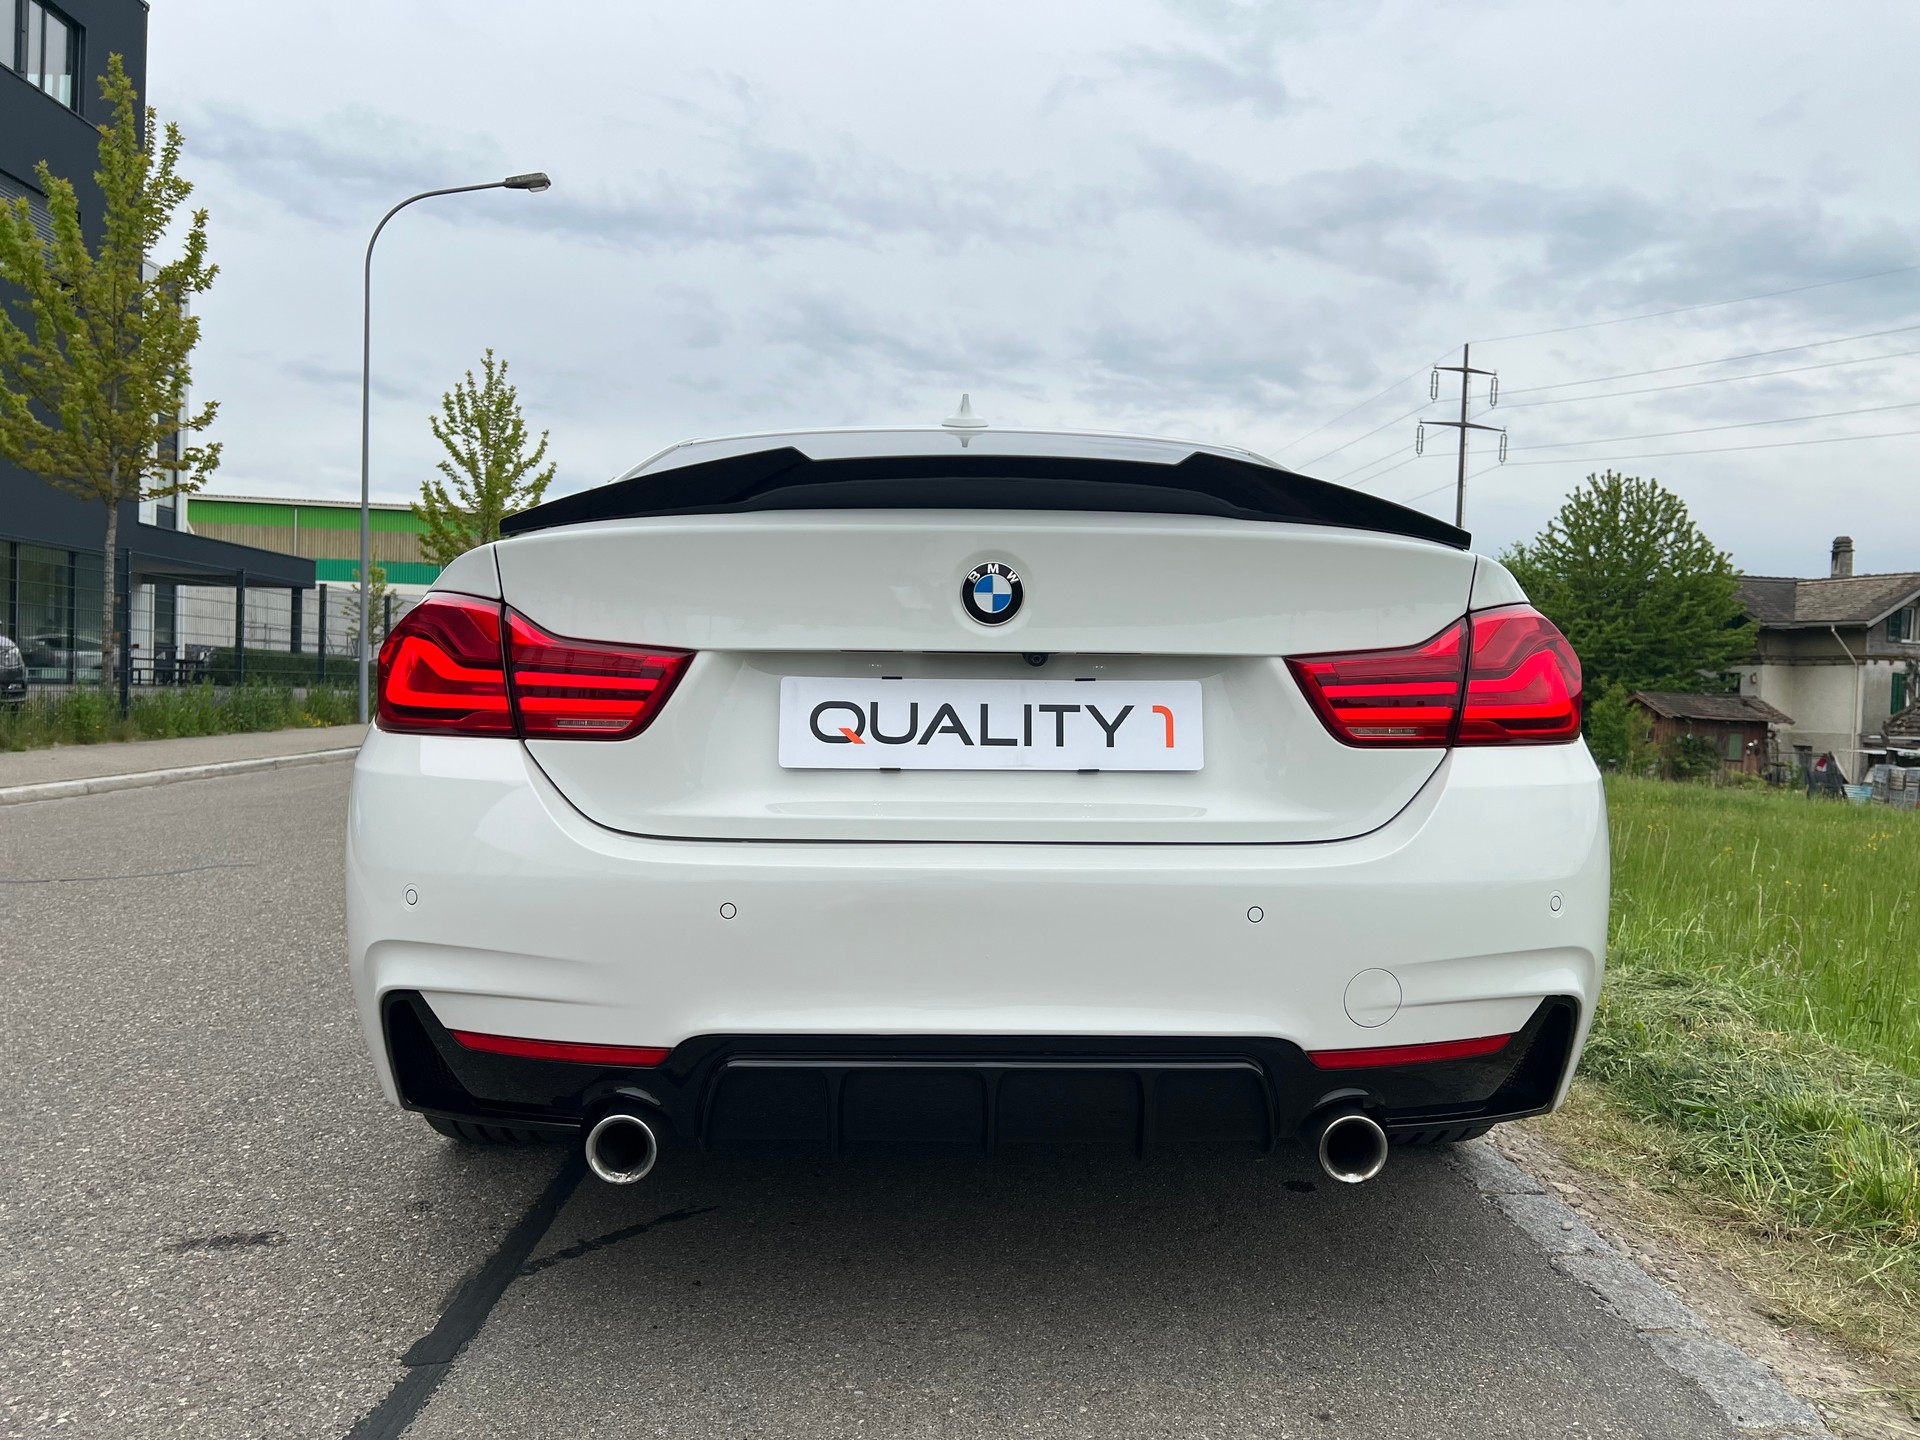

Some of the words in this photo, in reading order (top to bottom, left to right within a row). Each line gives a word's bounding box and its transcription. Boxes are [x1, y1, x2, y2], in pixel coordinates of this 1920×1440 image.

[968, 564, 1019, 584] BMW
[809, 700, 1135, 748] QUALITY
[1151, 704, 1175, 749] 1
